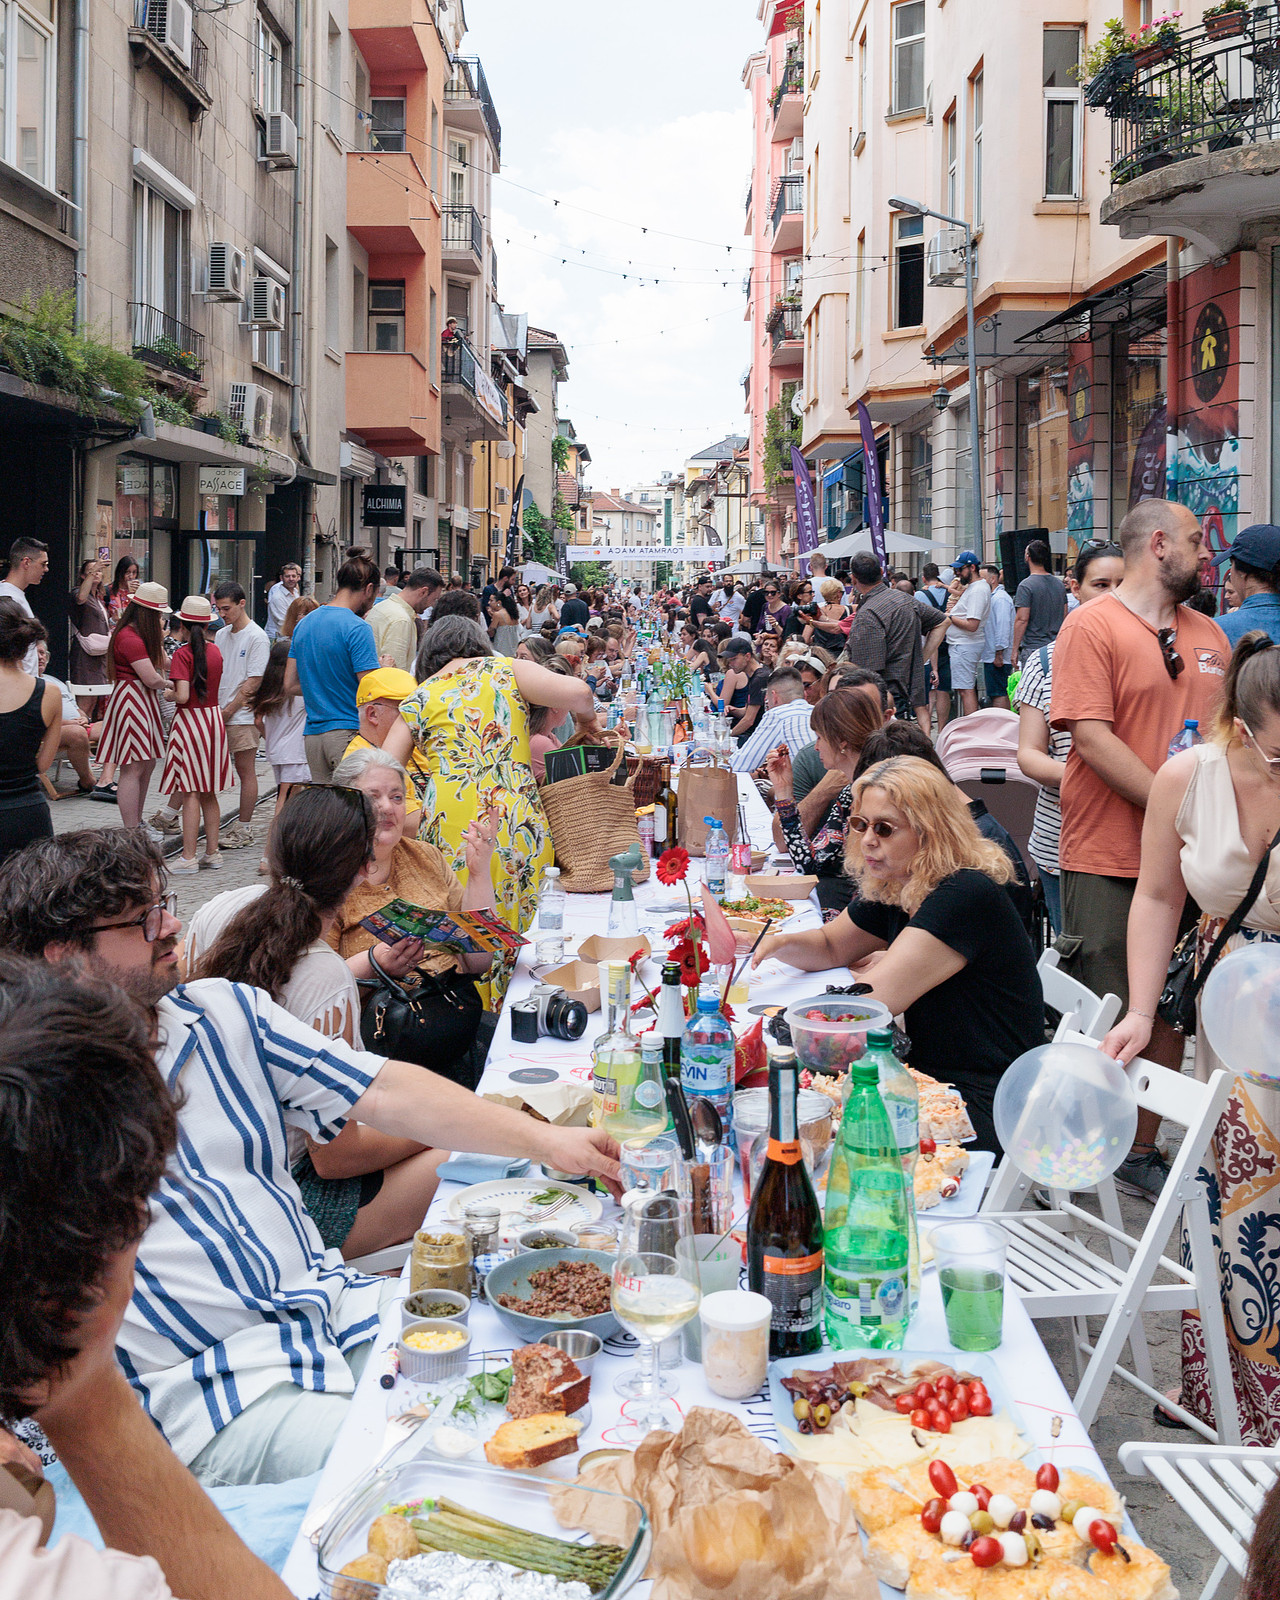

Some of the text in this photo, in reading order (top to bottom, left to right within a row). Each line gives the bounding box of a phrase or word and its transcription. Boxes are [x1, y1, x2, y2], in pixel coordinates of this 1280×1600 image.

[200, 477, 243, 493] PASSAGE
[366, 497, 402, 510] ALCHIMIA
[1198, 661, 1225, 677] Burto
[681, 1062, 708, 1081] EVIN
[824, 1293, 852, 1311] aguaro
